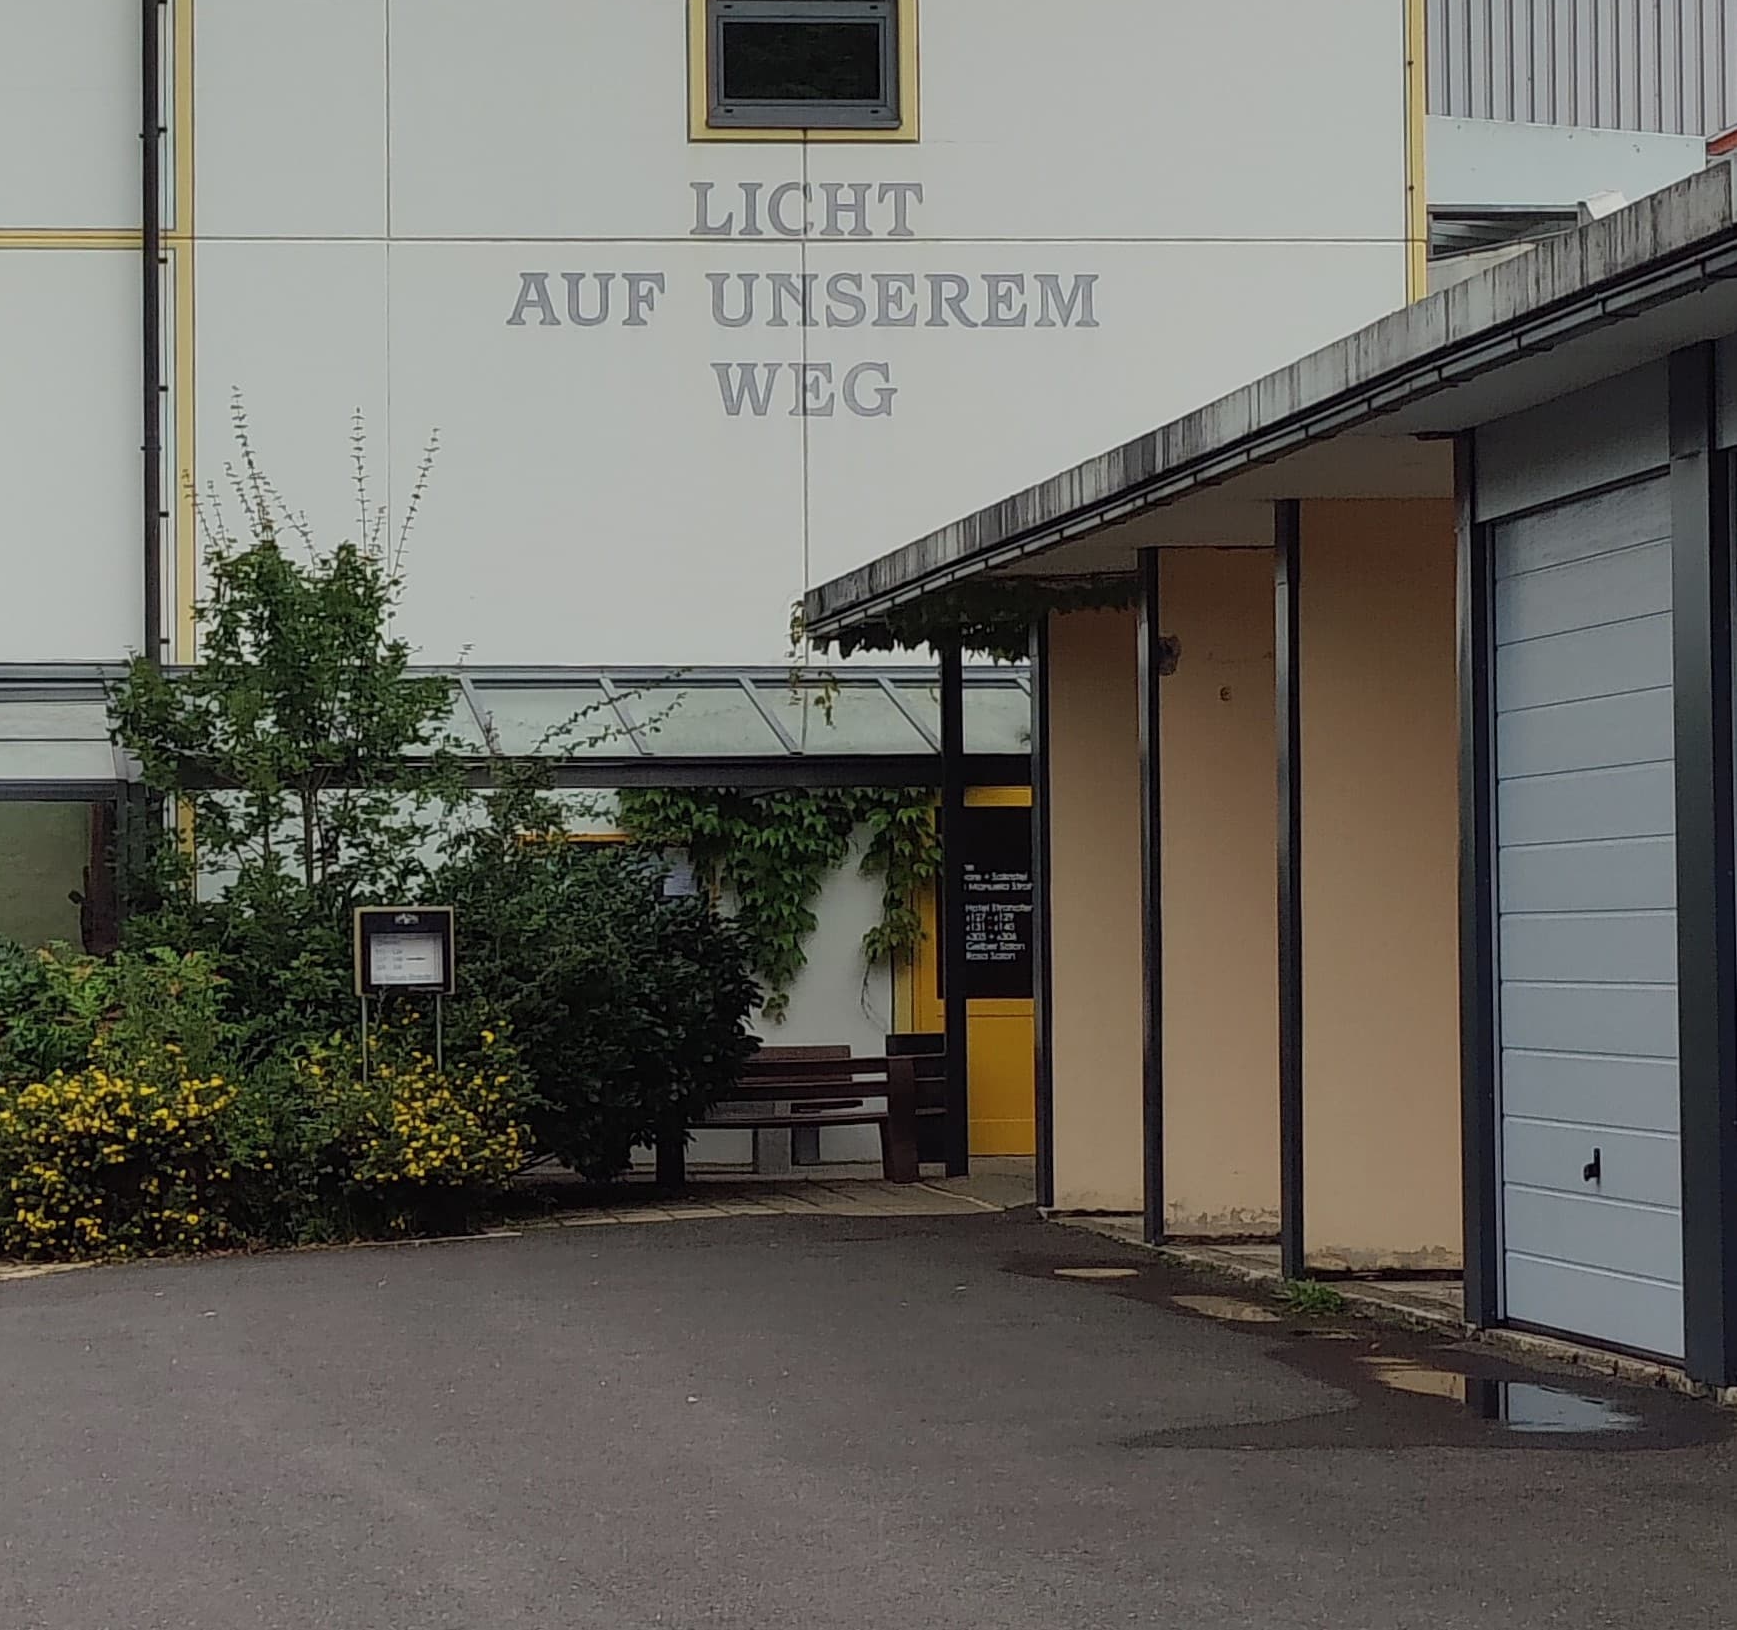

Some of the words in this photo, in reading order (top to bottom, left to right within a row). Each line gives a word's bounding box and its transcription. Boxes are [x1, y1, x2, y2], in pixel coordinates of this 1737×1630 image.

[689, 182, 924, 237] LICHT
[506, 272, 666, 327] AUF
[705, 273, 1100, 328] UNSEREM
[710, 362, 898, 418] WEG
